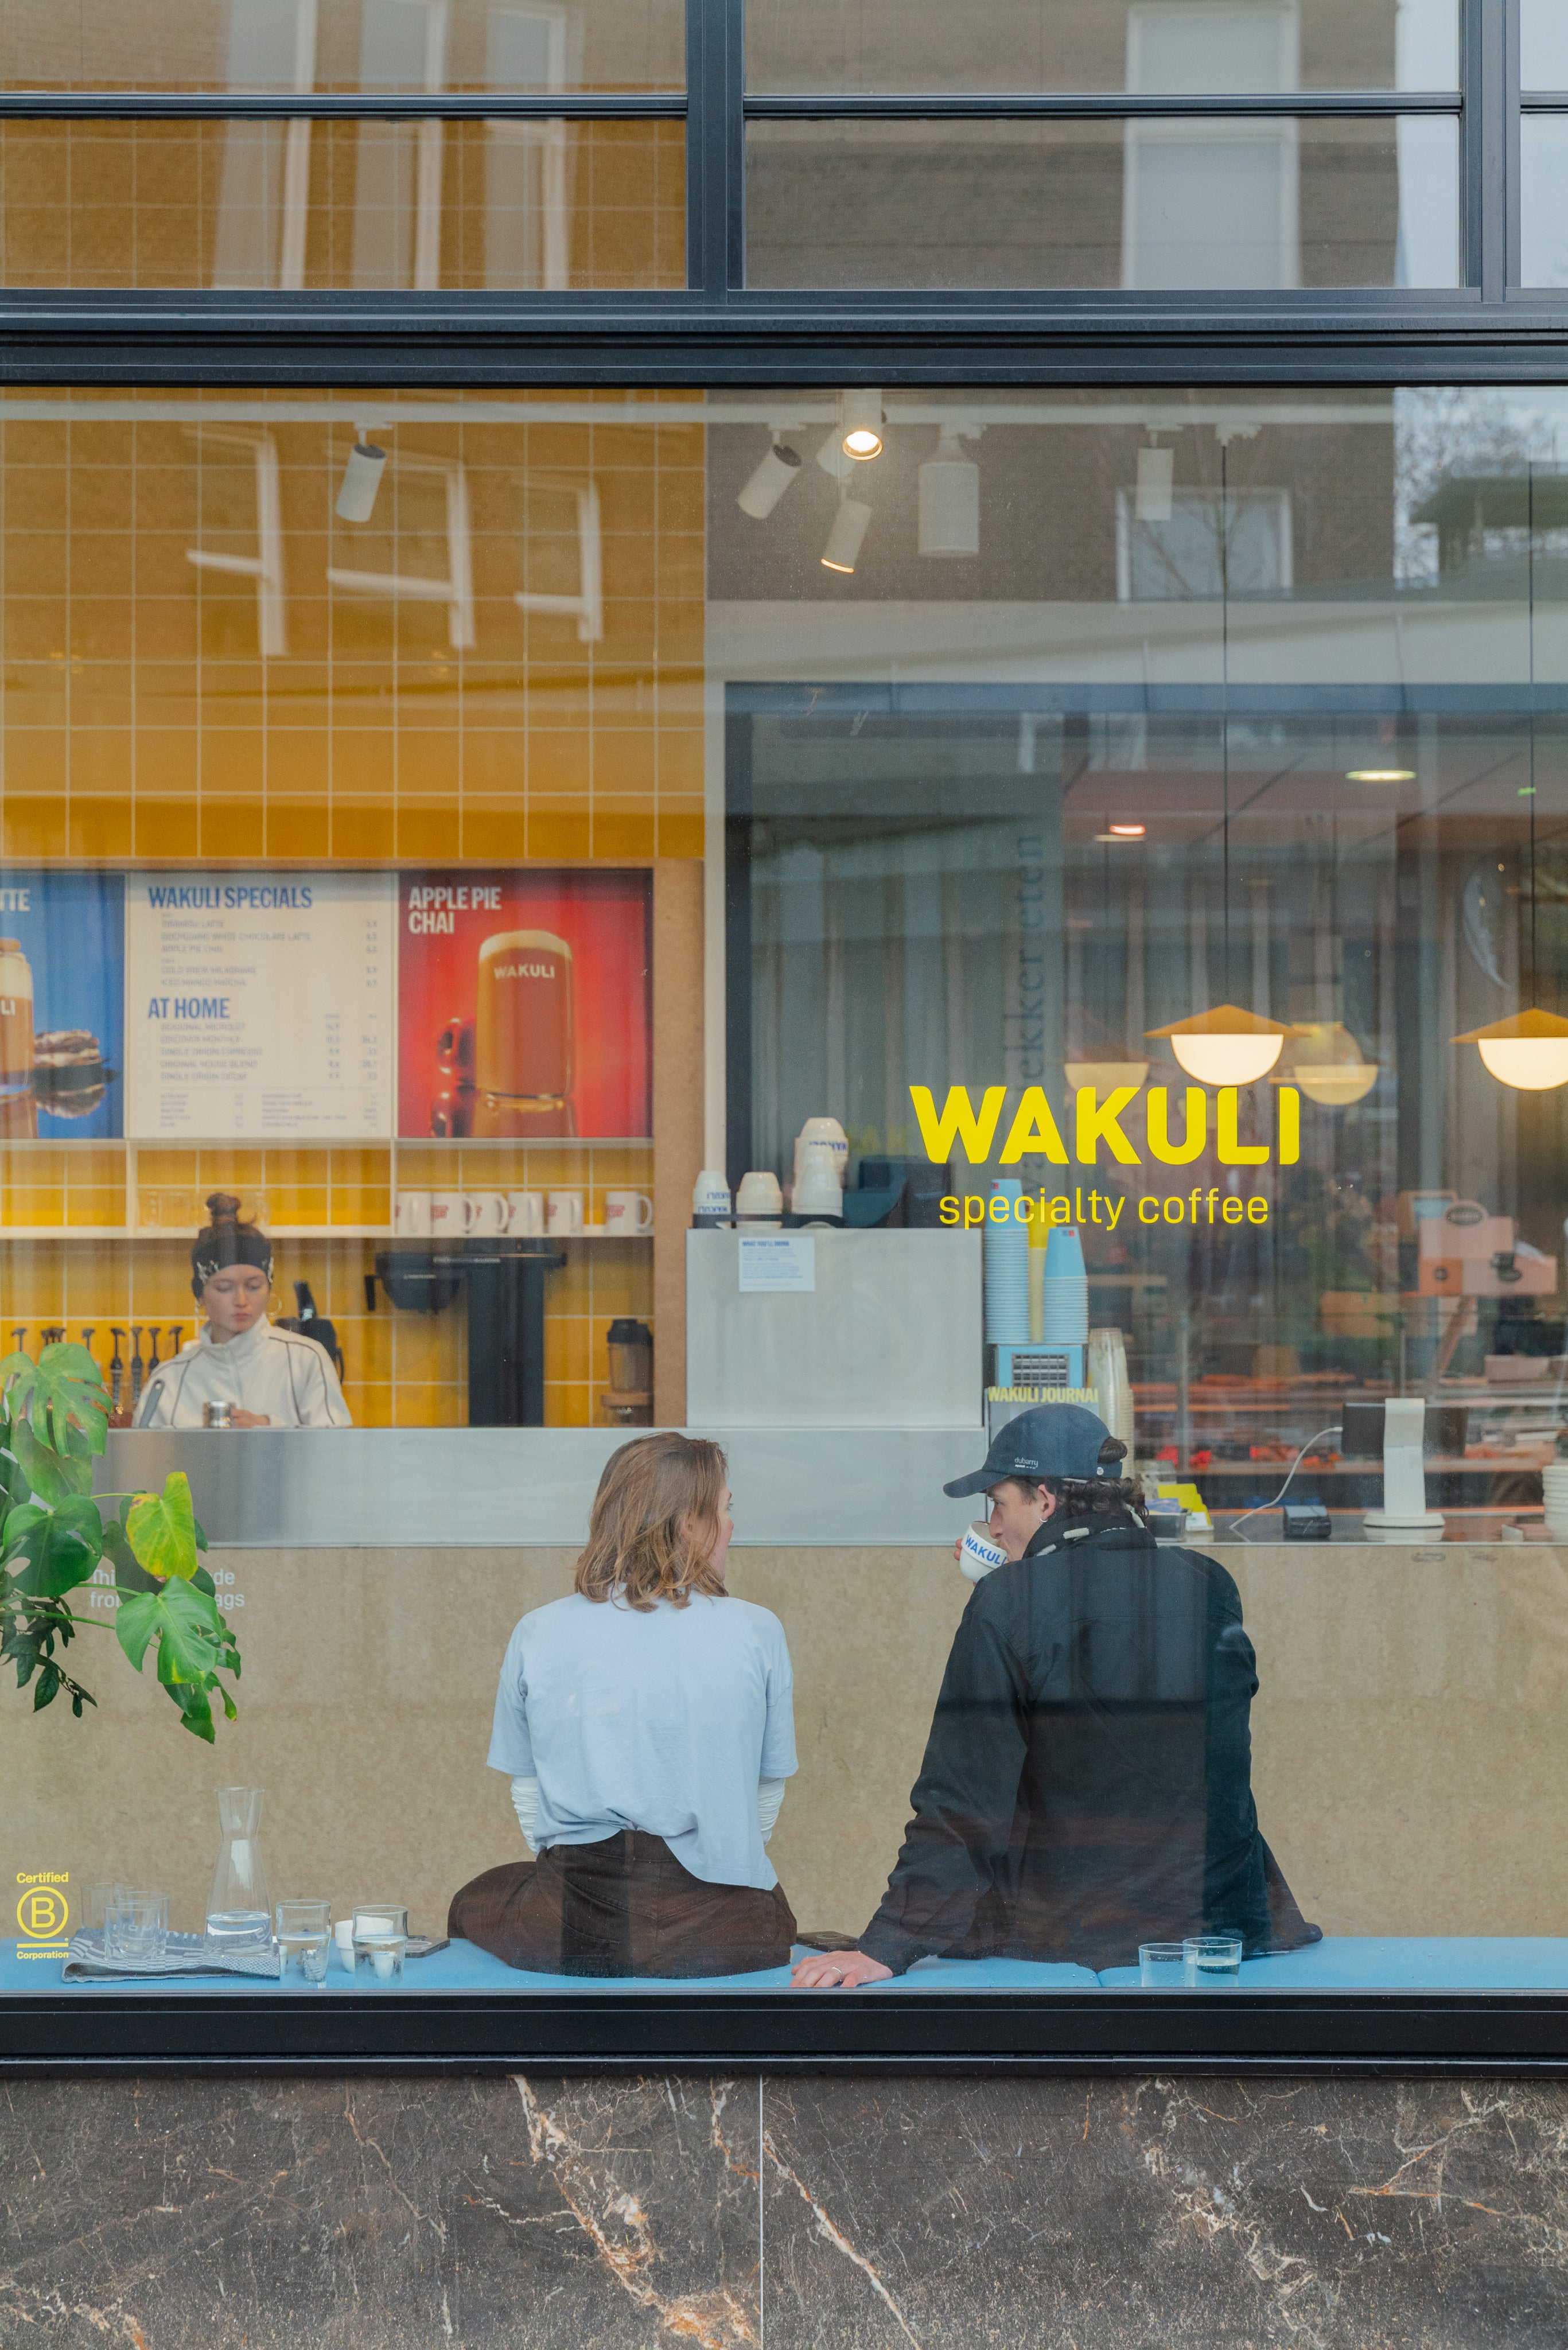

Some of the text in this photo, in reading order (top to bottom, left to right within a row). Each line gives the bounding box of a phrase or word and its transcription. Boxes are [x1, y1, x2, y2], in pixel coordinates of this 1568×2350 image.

[147, 886, 313, 909] WAKULI SPECIALS
[408, 887, 501, 910] APPLE PIE
[408, 911, 454, 934] CHAI
[493, 964, 555, 980] WAKULI
[147, 998, 230, 1019] AT HOME
[909, 1086, 1299, 1165] WAKULI
[940, 1188, 1268, 1230] specialty coffee
[989, 1386, 1039, 1402] WAKULI
[1014, 1457, 1038, 1468] dubarry
[966, 1534, 1007, 1566] WAKULI
[17, 1872, 69, 1884] Certified
[32, 1897, 56, 1928] B
[17, 1951, 69, 1960] Corporation
